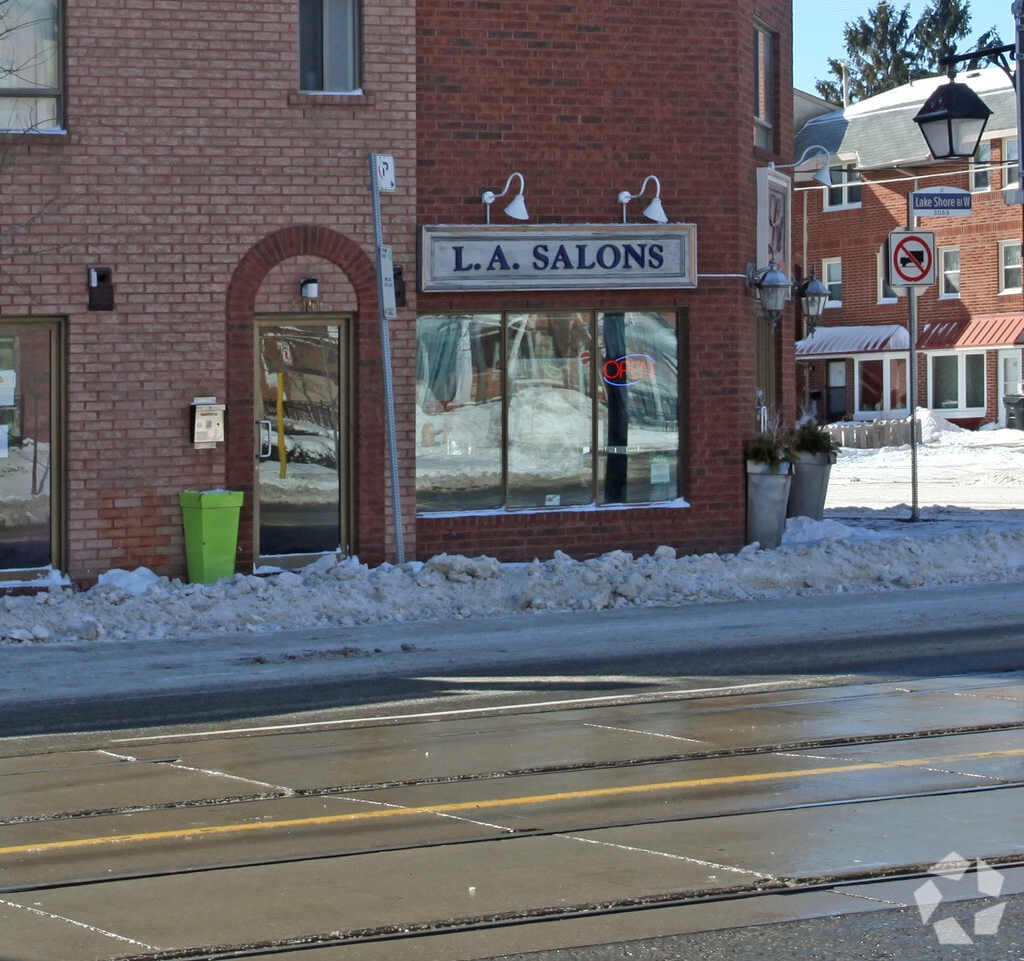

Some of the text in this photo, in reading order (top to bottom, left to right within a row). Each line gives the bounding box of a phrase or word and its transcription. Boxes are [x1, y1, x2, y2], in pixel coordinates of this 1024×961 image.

[915, 196, 932, 207] Lake
[933, 196, 956, 207] Shore
[963, 196, 971, 206] W
[452, 243, 665, 272] L.A. SALONS
[603, 359, 655, 379] OPEN
